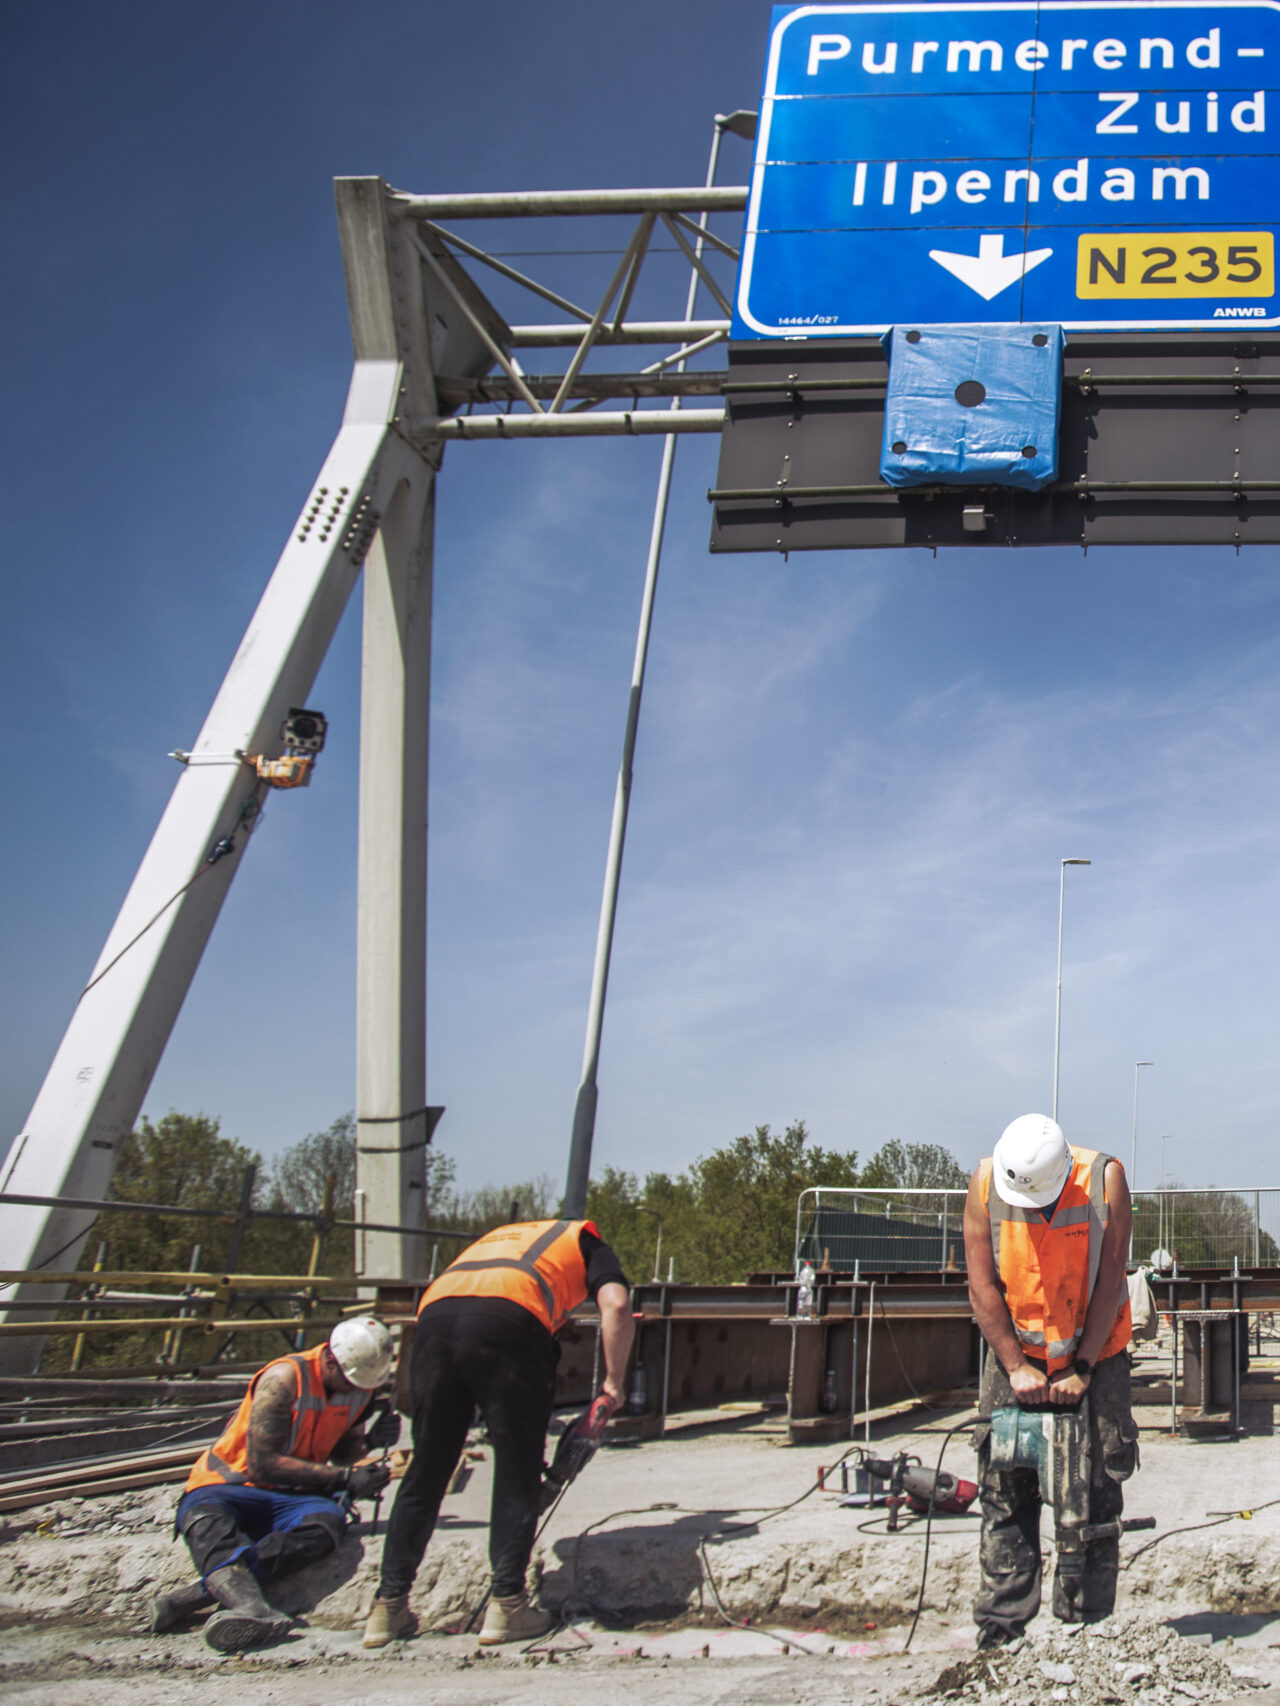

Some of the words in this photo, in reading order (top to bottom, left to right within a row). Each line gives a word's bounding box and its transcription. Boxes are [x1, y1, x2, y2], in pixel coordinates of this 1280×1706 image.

[806, 28, 1265, 76] Purmerend-
[1095, 90, 1266, 134] Zuid
[852, 158, 1210, 215] Ilpendam
[778, 314, 839, 325] 14464/027
[1213, 307, 1267, 317] ANWB
